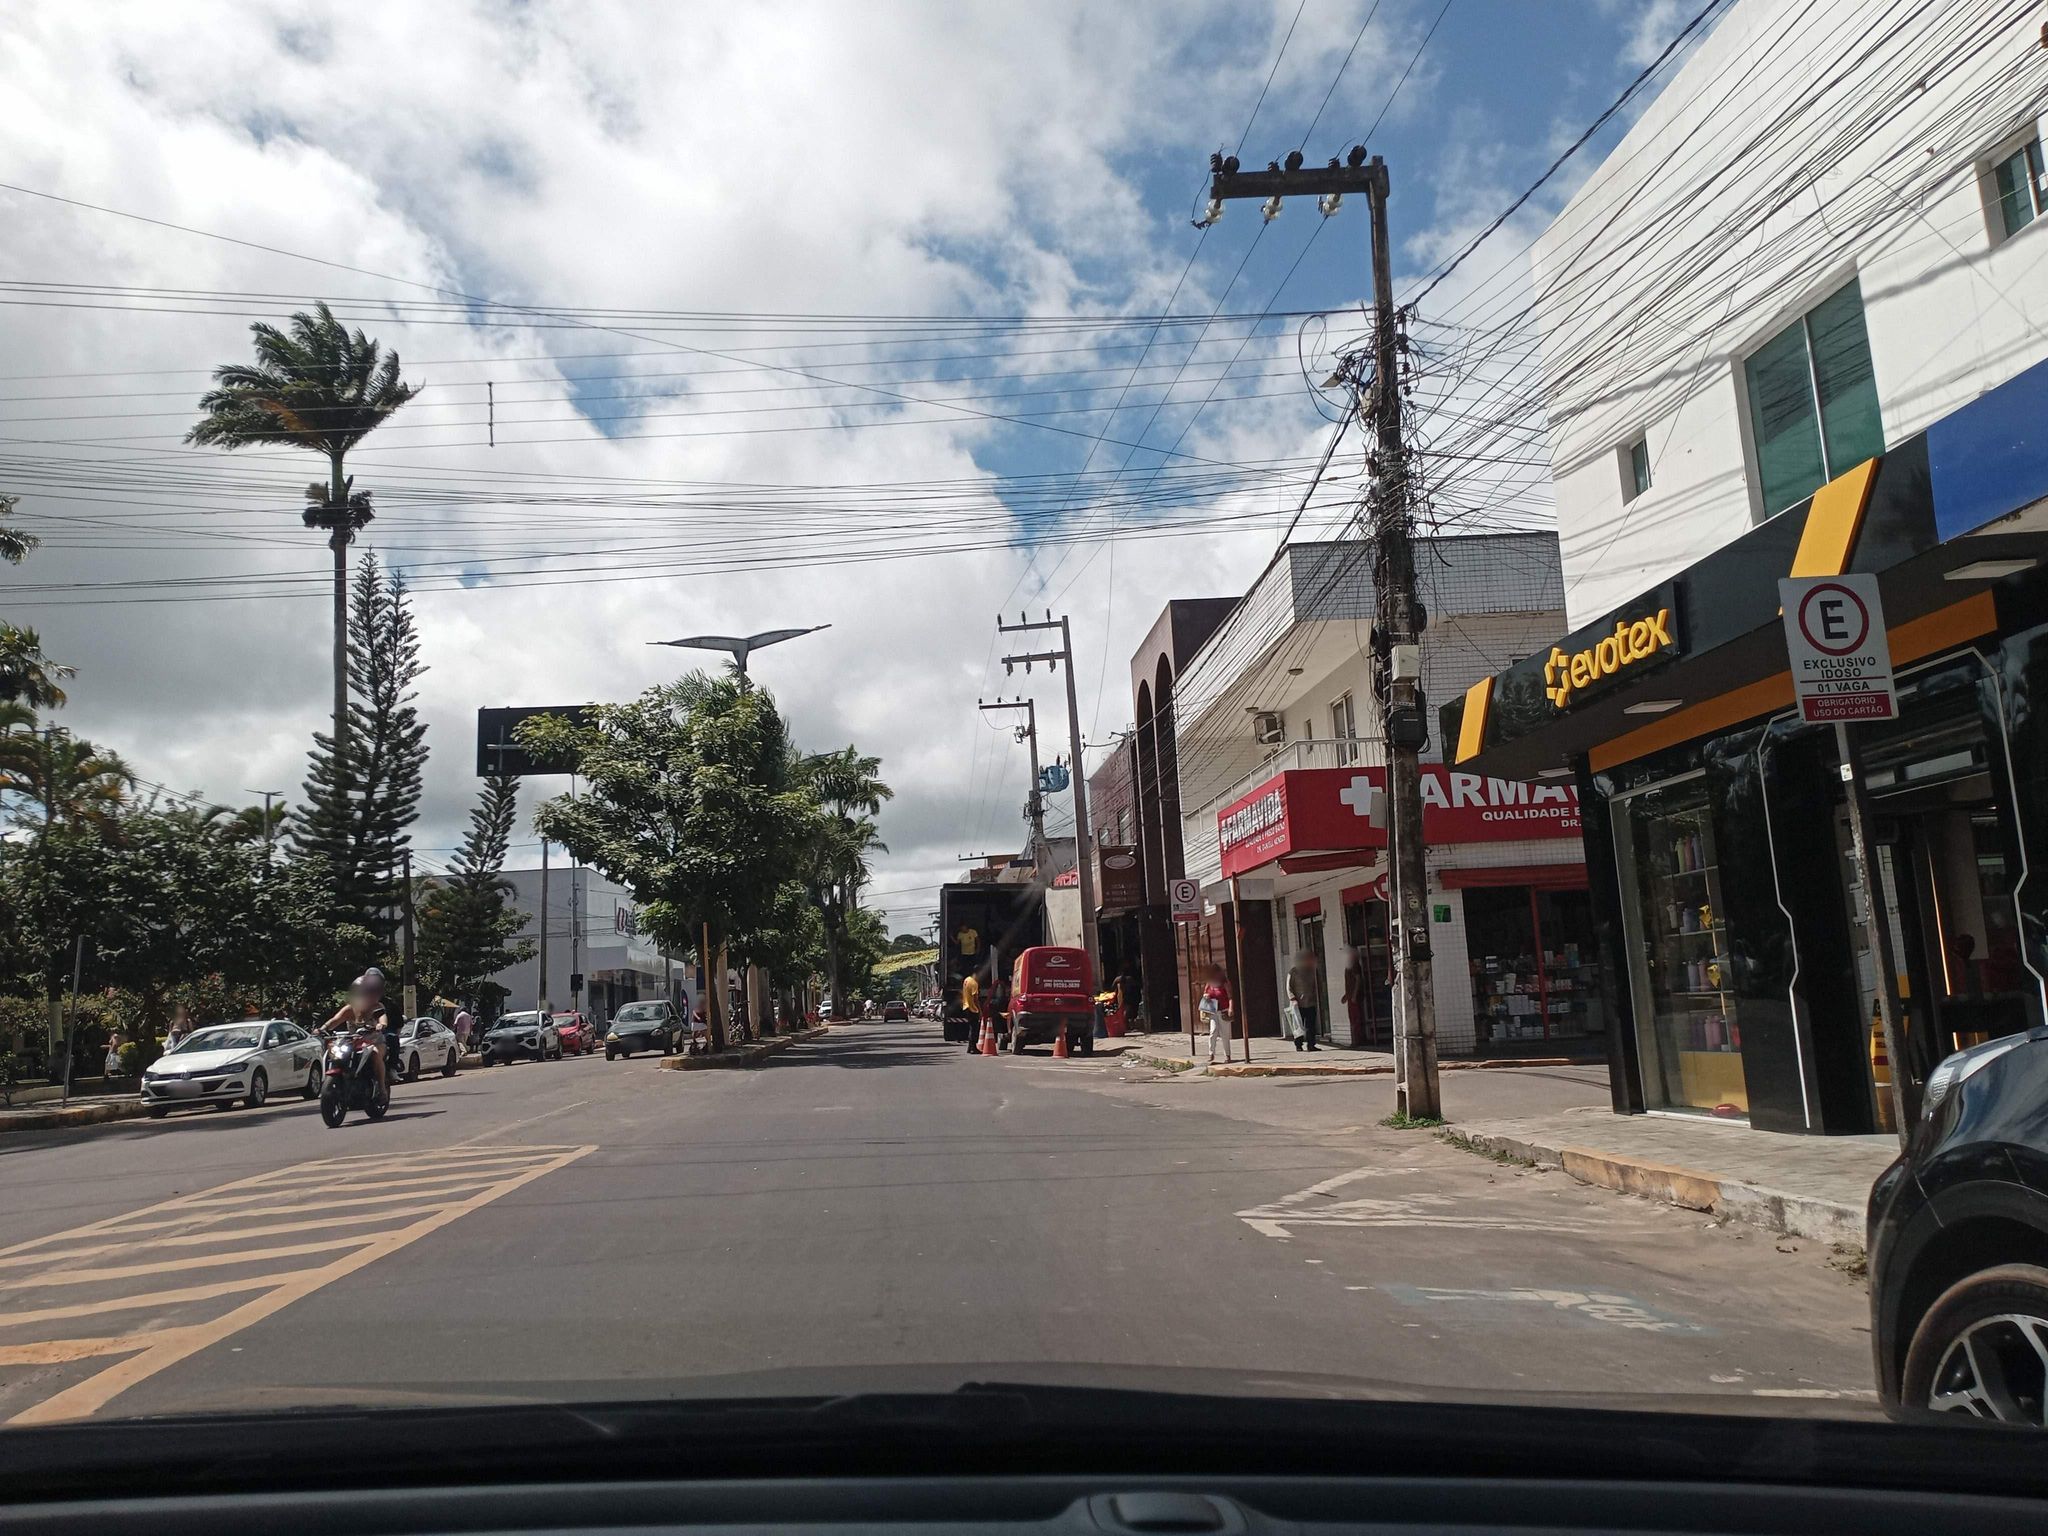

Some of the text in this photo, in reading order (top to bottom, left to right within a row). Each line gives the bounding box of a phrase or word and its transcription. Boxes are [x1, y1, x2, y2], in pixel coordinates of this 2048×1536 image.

[1820, 600, 1848, 639] E
[1571, 609, 1671, 688] evotex
[1803, 656, 1876, 670] EXCLUSIVO
[1821, 668, 1861, 679] IDOSO
[1817, 681, 1870, 693] 01 VAGA
[1813, 705, 1883, 717] USO DO CARTÃO
[1420, 773, 1578, 808] ARMA
[1482, 807, 1570, 821] QUALIDADE
[1561, 819, 1582, 828] DR.
[1181, 886, 1190, 899] E
